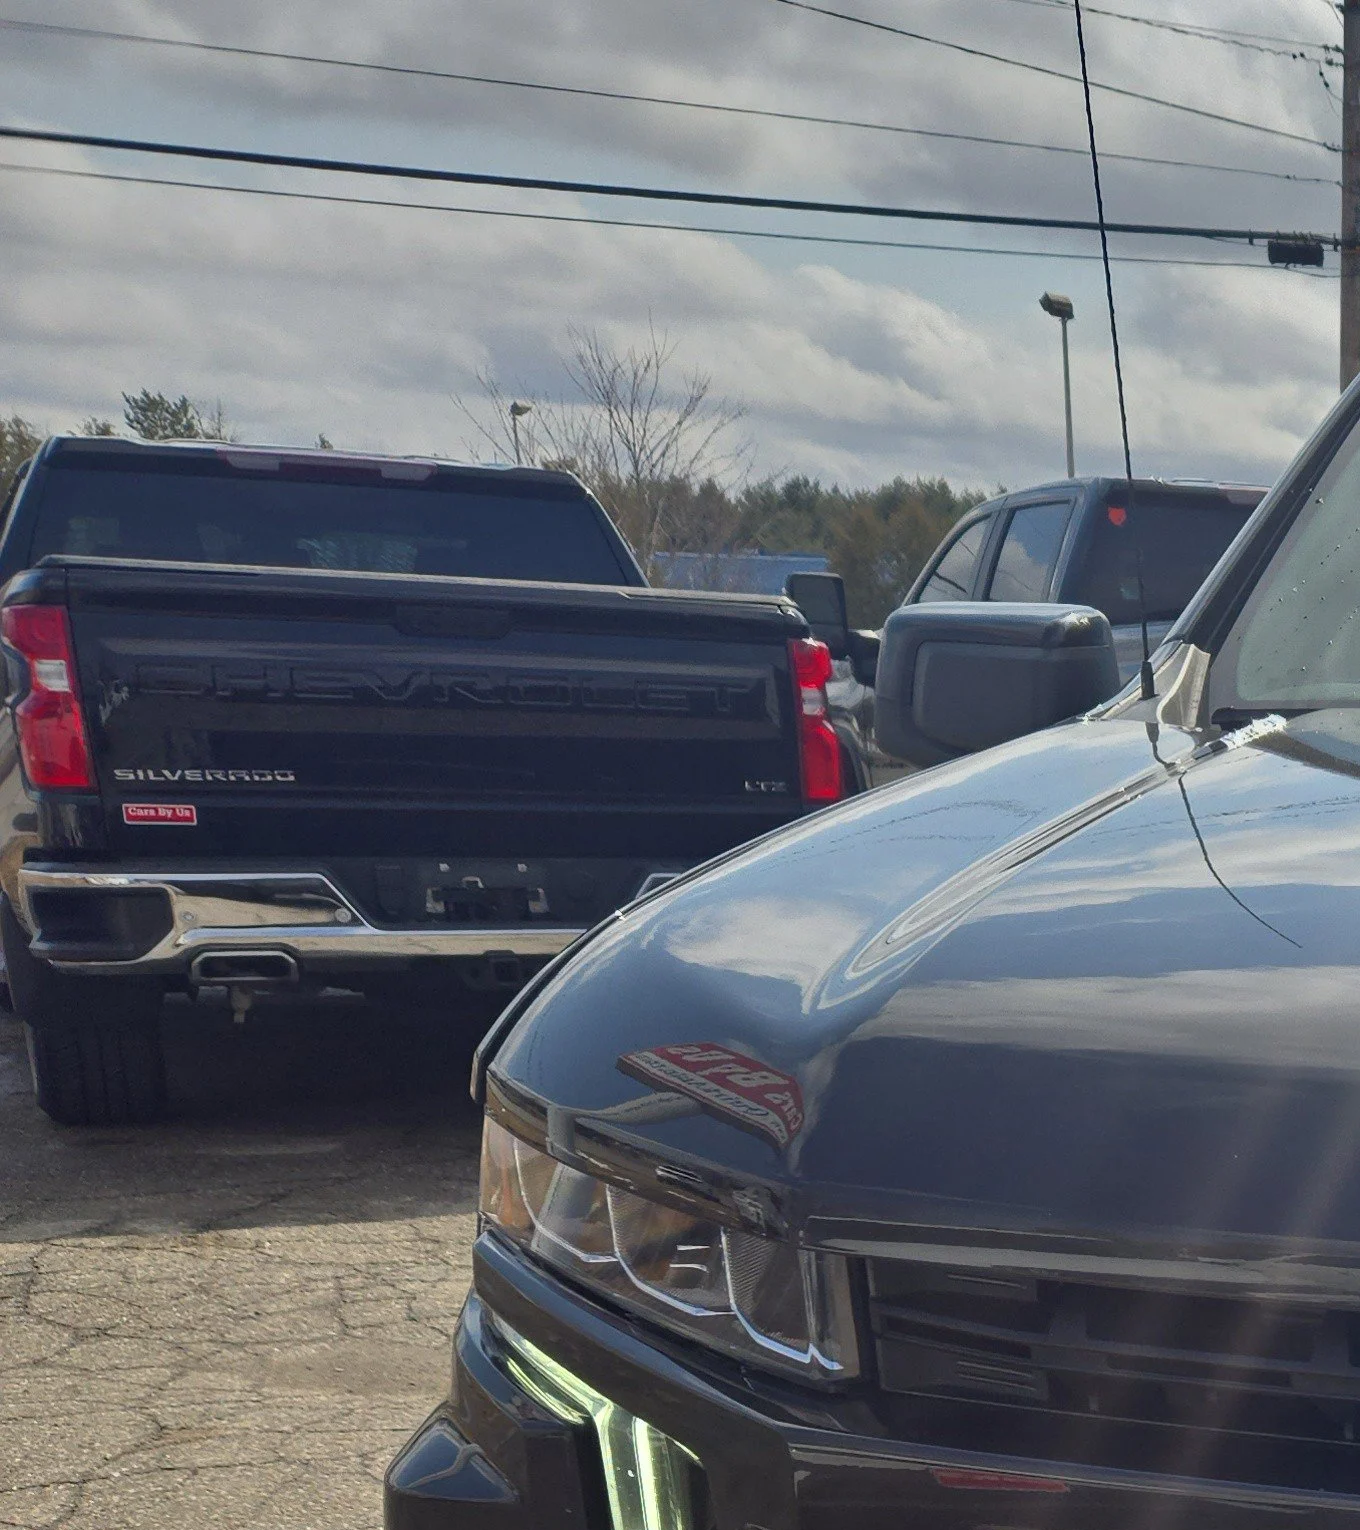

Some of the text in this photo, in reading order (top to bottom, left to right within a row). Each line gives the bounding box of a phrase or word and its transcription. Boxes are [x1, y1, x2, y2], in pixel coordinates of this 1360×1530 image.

[134, 662, 753, 714] CHEVROLET
[113, 768, 296, 782] SILVERADO
[128, 807, 192, 818] Cars By Us
